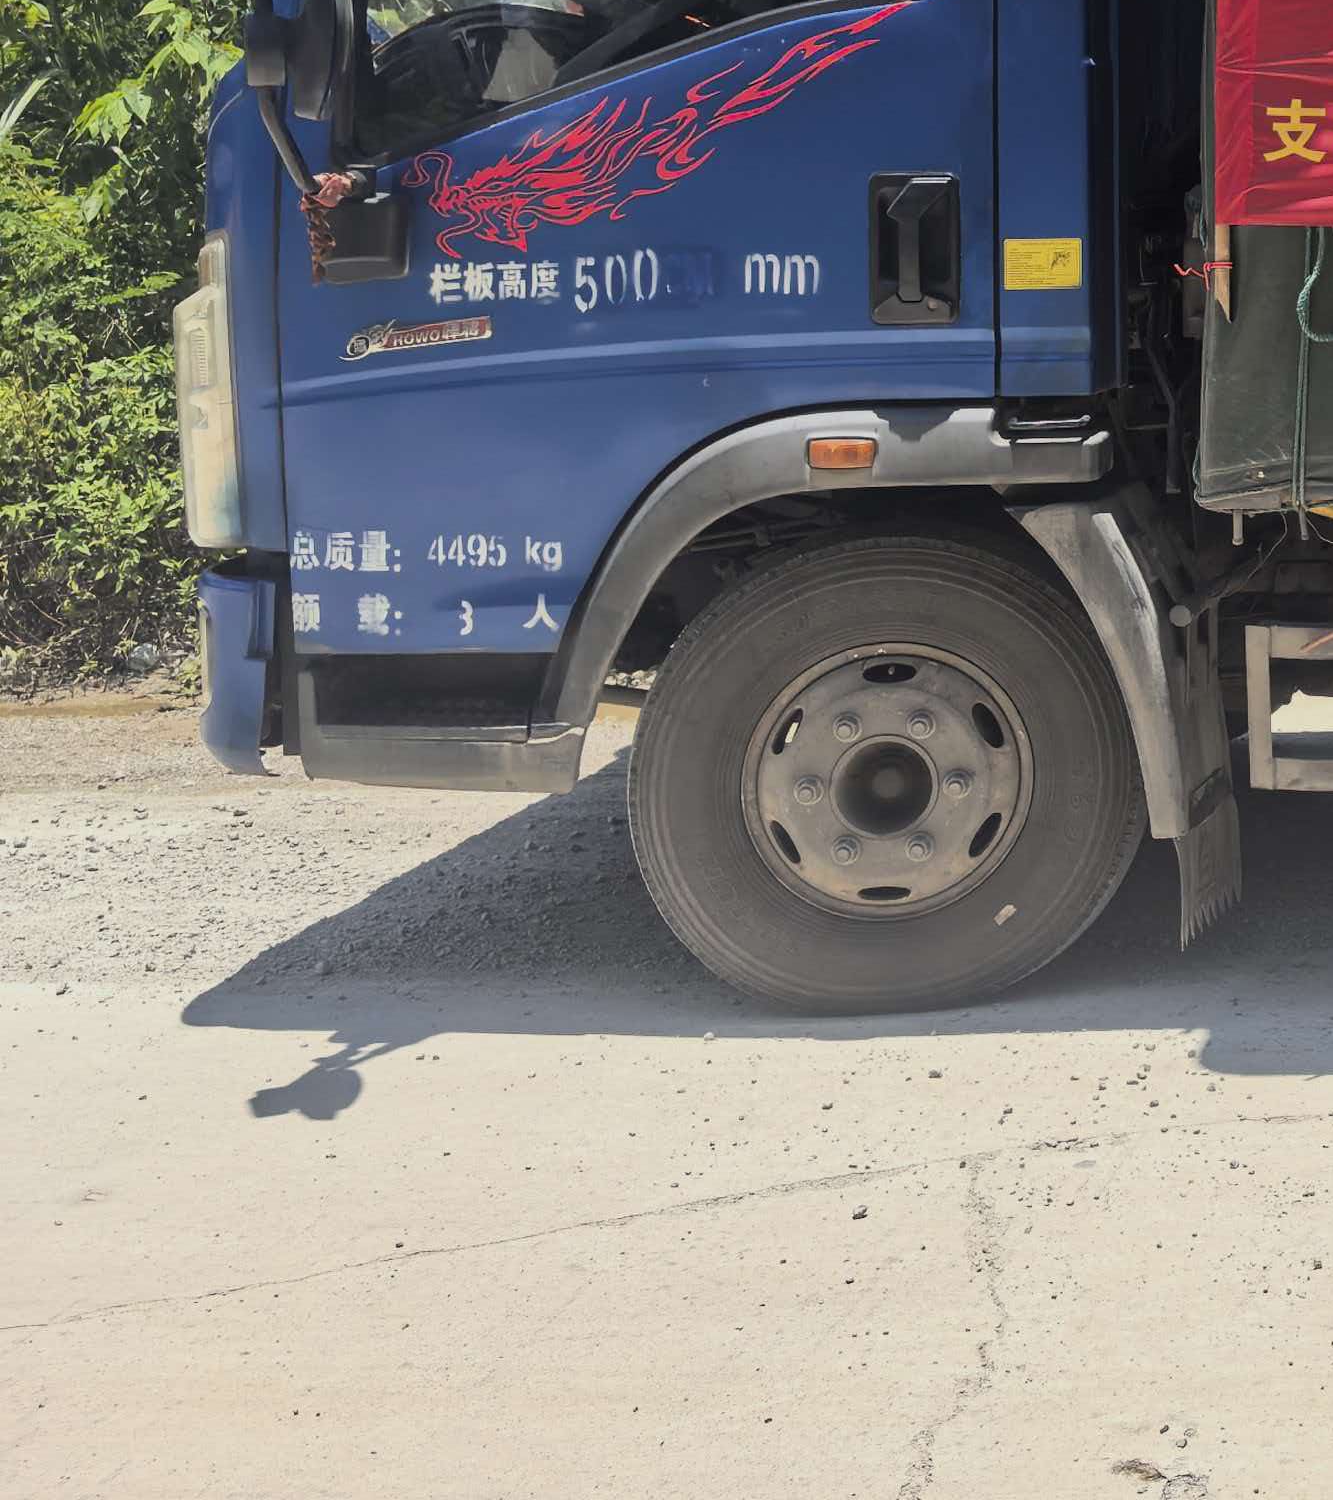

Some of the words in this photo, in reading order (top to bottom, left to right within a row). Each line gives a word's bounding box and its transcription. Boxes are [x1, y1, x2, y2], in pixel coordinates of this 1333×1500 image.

[430, 260, 560, 304] 栏板高度
[744, 254, 820, 295] mm
[427, 534, 507, 567] 4495
[525, 536, 563, 572] kg
[458, 600, 474, 636] 3
[522, 593, 560, 632] 人
